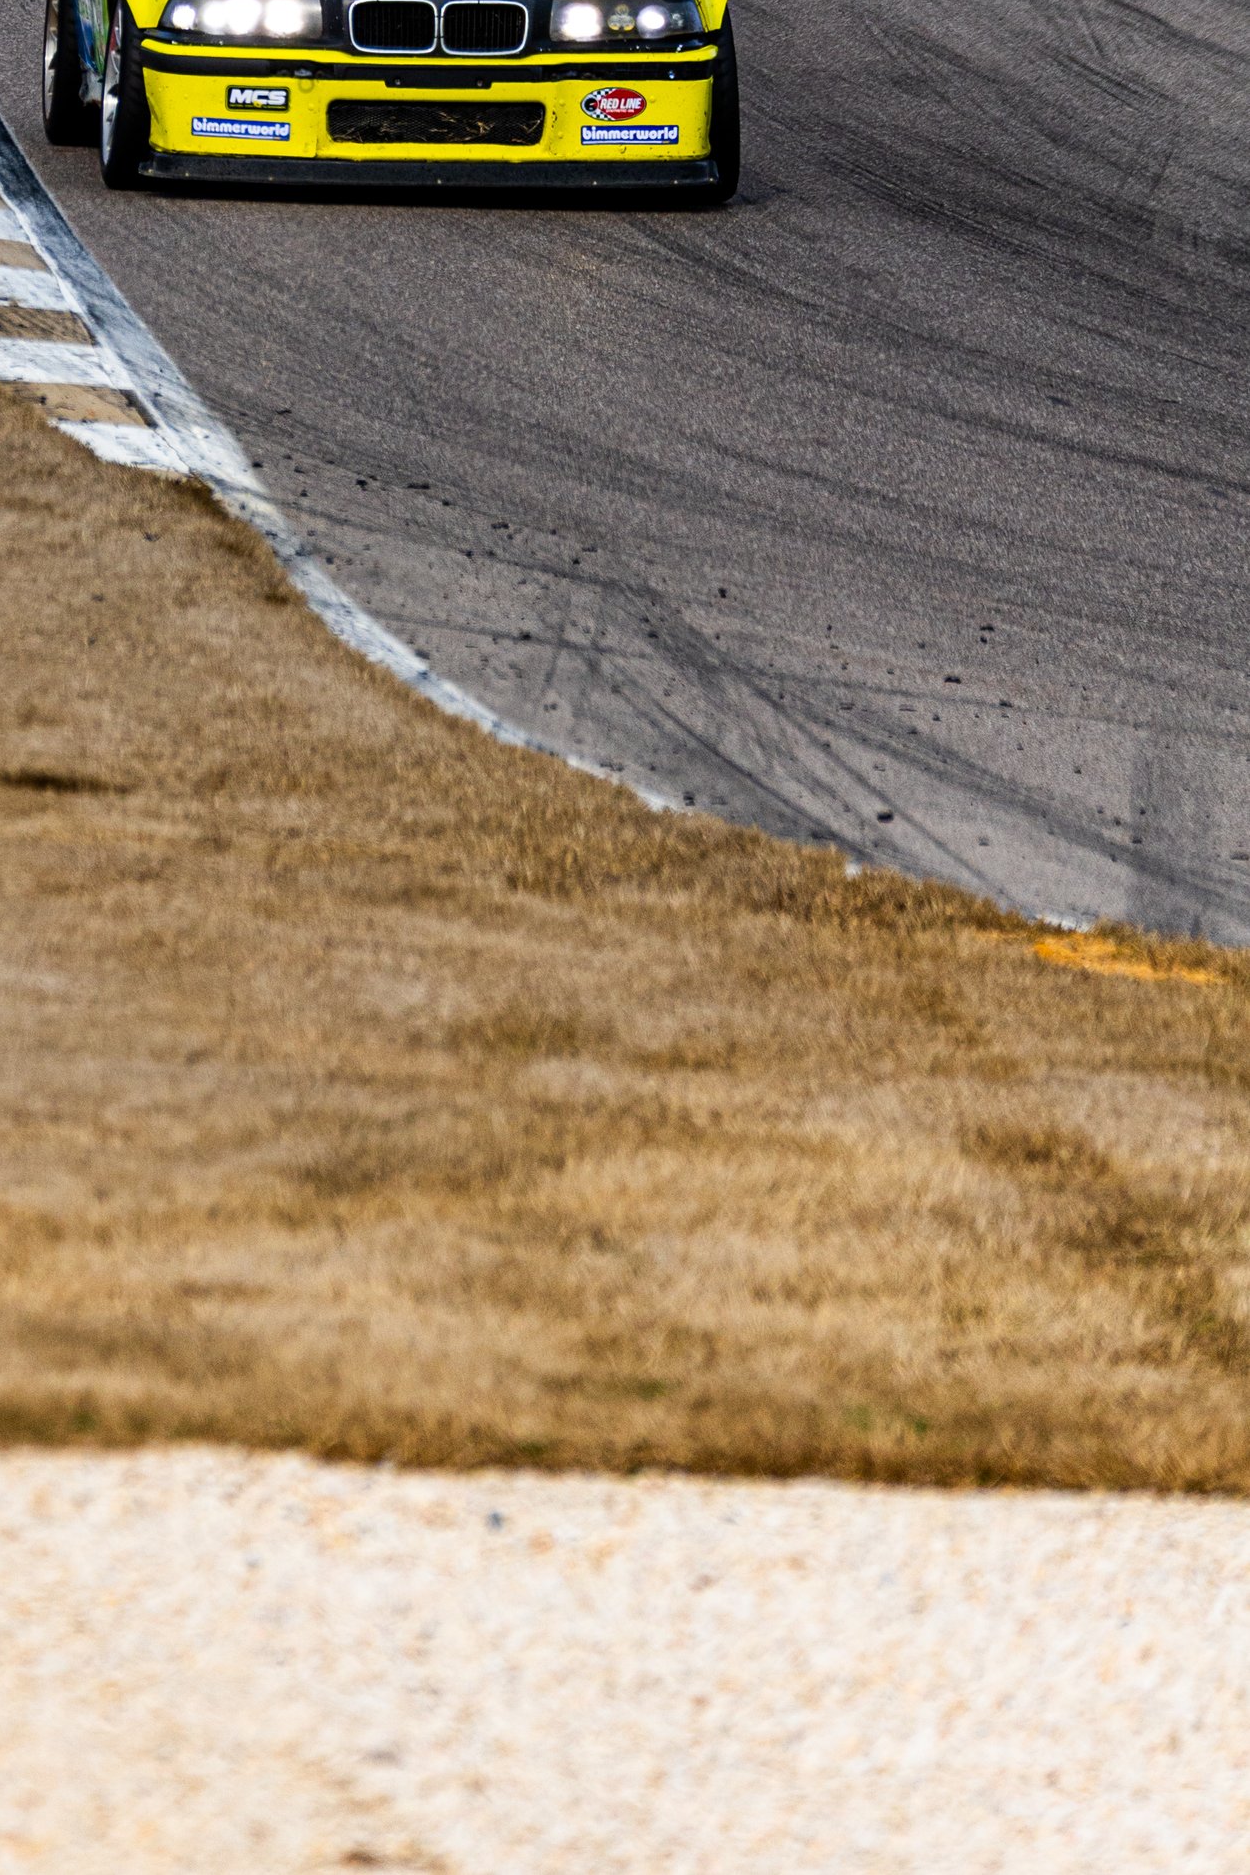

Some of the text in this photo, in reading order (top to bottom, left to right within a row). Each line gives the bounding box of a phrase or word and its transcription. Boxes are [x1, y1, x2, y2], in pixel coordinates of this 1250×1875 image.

[229, 88, 287, 105] MCS
[600, 98, 642, 109] RED LINE
[193, 118, 290, 136] bimmerworld
[582, 126, 678, 140] bimmerworld
